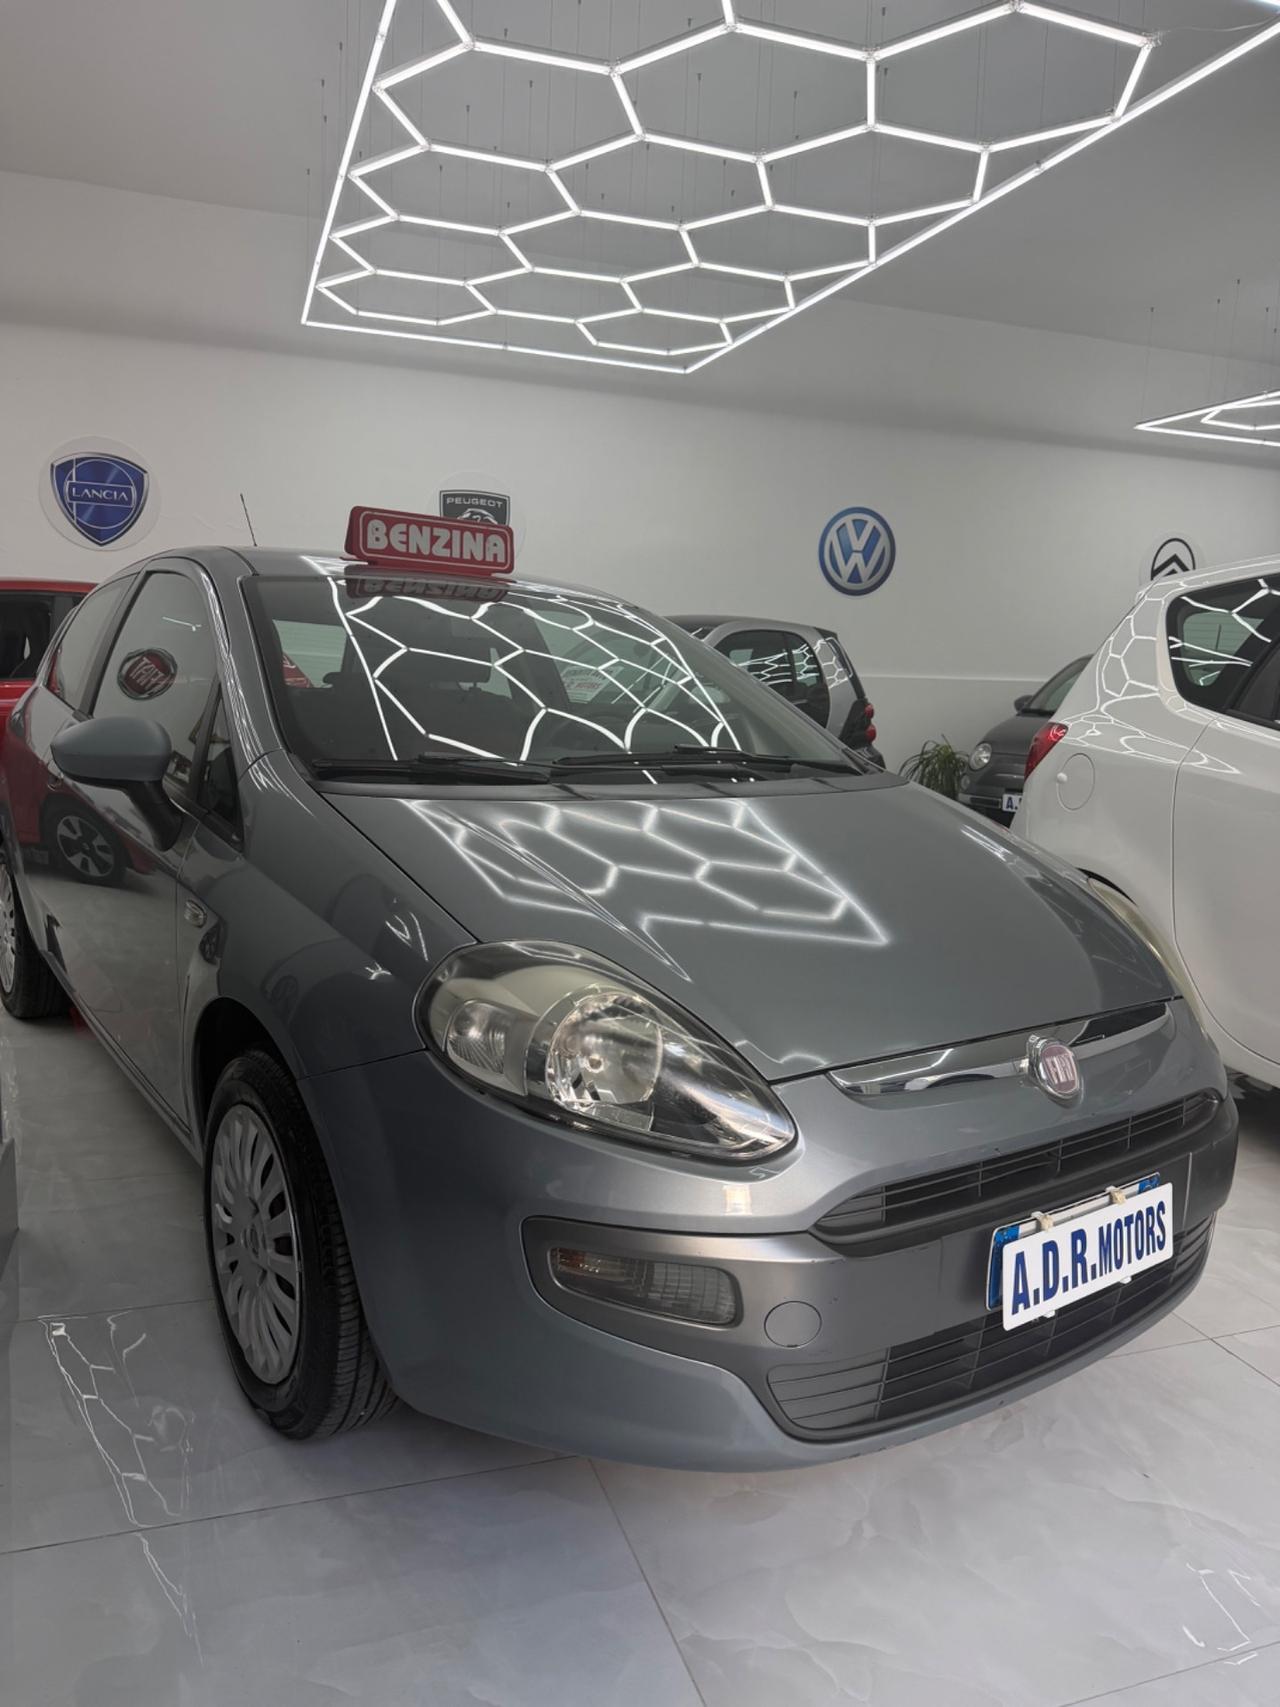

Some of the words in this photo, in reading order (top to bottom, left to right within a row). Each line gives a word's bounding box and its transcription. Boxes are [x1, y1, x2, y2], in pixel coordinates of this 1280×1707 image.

[72, 487, 129, 501] LANCIA
[446, 496, 503, 509] PEUGEOT
[366, 518, 506, 564] BENZINA
